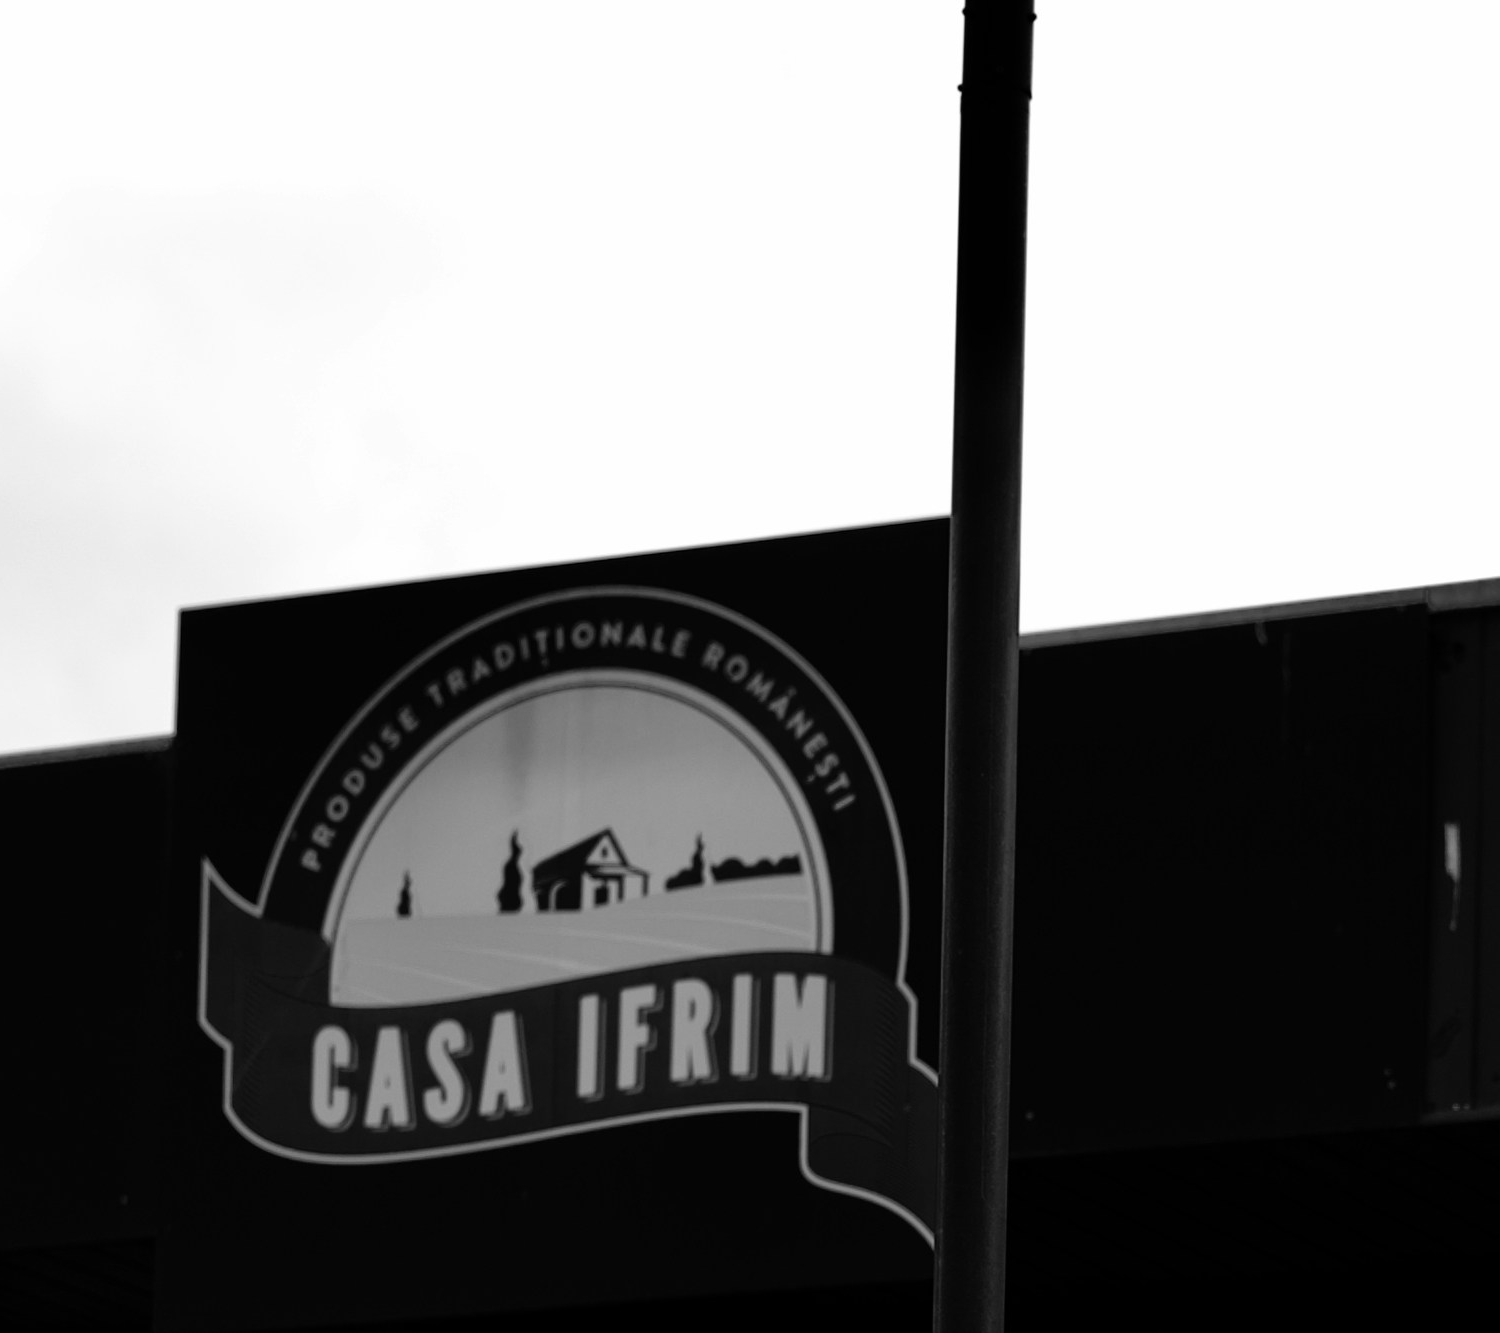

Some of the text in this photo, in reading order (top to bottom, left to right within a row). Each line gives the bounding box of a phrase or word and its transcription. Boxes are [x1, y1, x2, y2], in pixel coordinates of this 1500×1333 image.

[300, 704, 419, 873] PRODUSE
[309, 971, 835, 1133] CASA IFRIM
